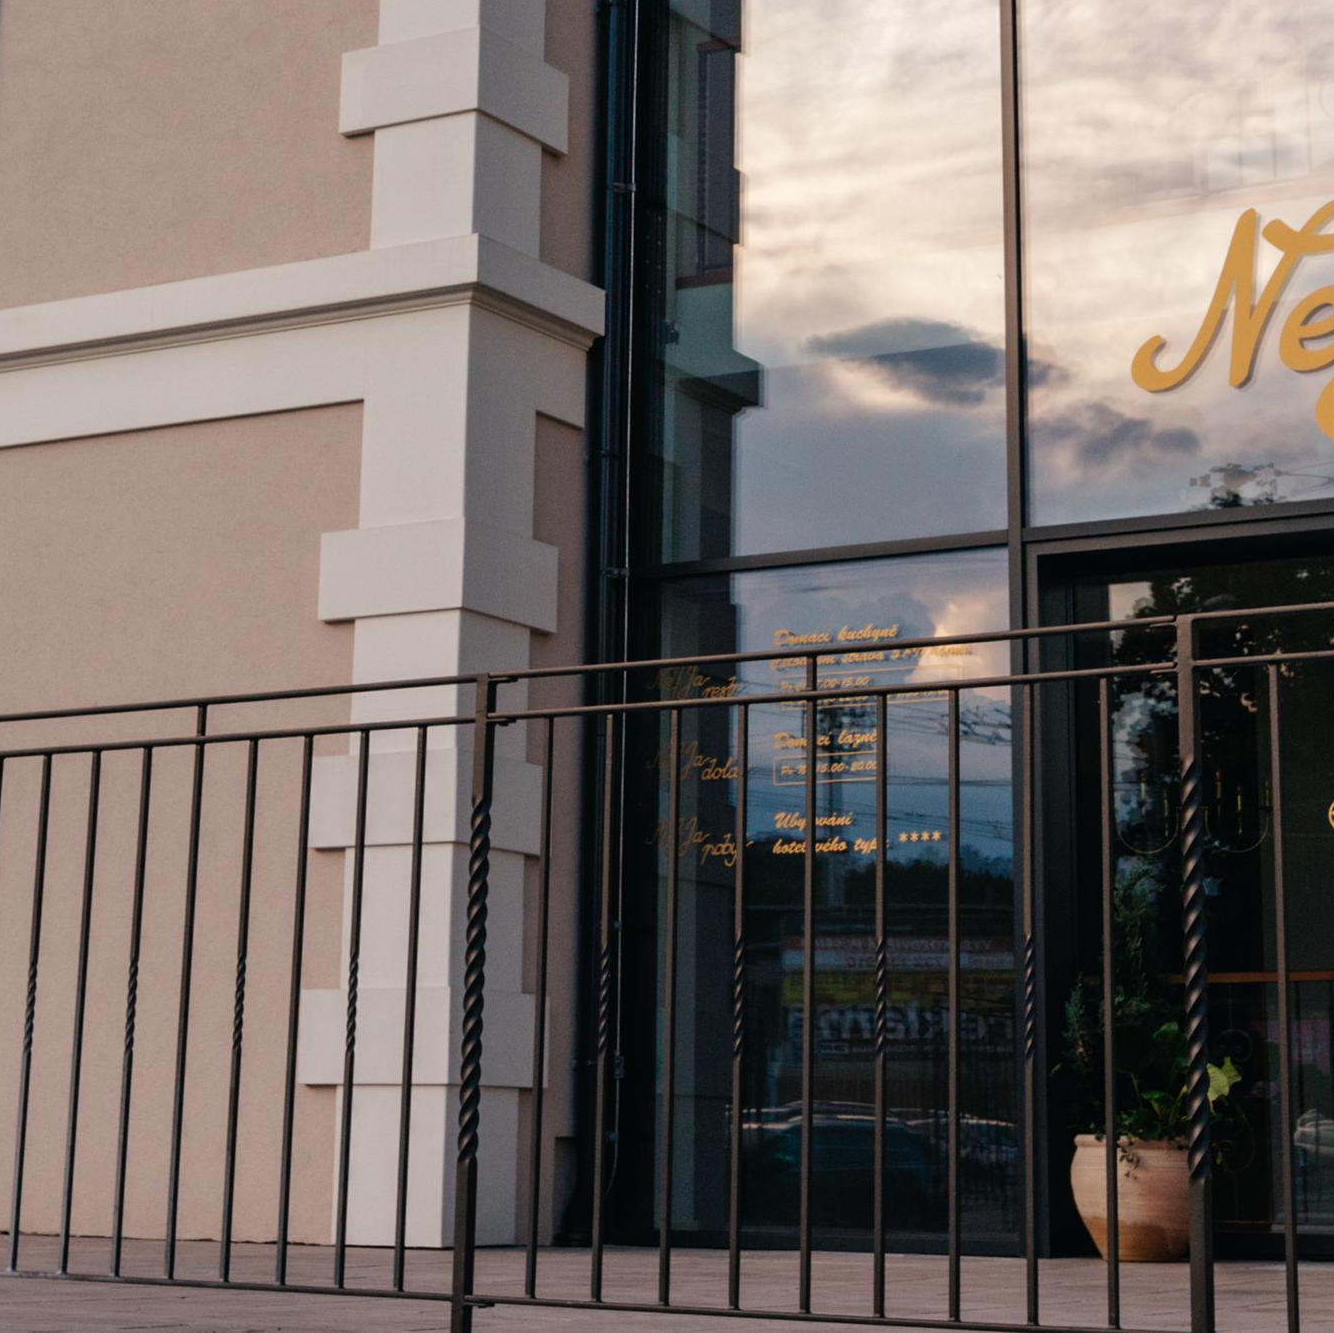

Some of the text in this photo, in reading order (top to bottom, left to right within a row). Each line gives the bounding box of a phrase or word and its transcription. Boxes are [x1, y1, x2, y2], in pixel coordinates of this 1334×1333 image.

[772, 731, 832, 749] Domcí
[773, 835, 890, 854] hotelvého typ
